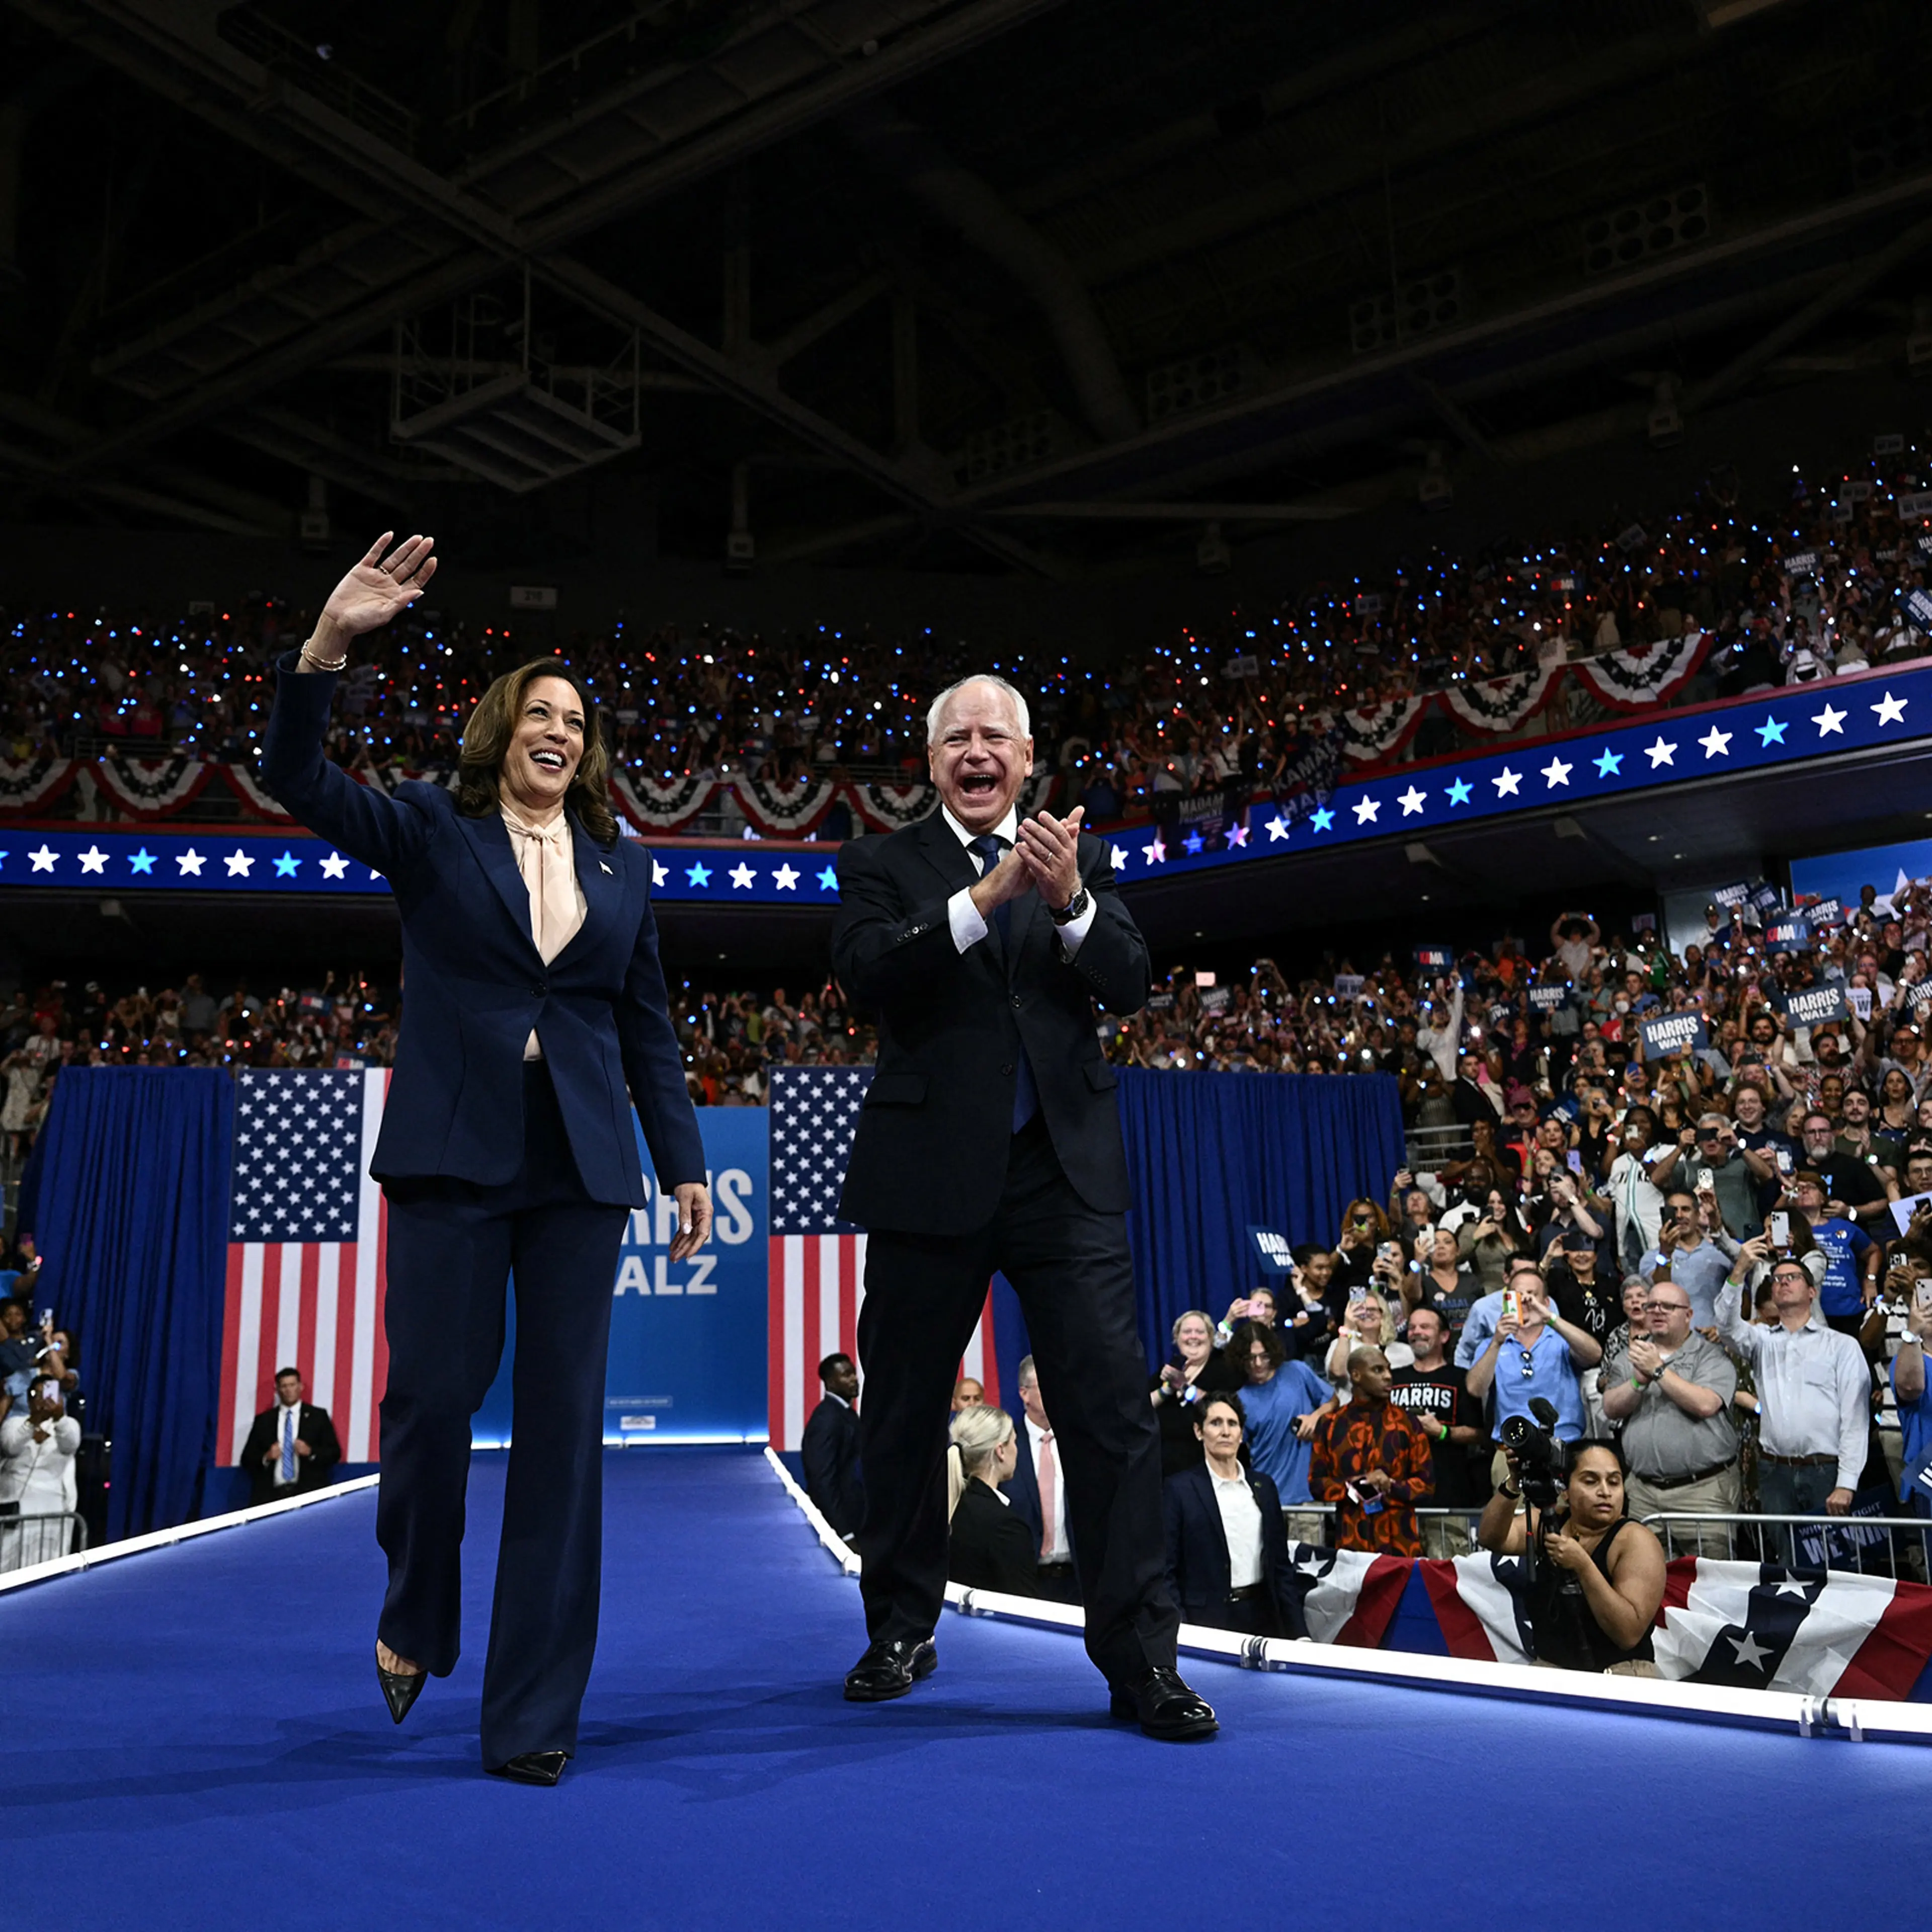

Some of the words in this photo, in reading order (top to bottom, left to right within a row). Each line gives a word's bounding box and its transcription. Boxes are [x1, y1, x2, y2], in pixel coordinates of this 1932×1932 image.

[1784, 552, 1816, 570] HARRIS
[1766, 924, 1807, 942] KAMALA
[1530, 987, 1565, 1002] HARRIS
[1788, 987, 1840, 1015] HARRIS
[1799, 1005, 1836, 1022] WALZ
[1646, 1015, 1700, 1043] HARRIS
[1272, 1253, 1296, 1267] WA
[613, 1255, 717, 1296] ALZ
[1390, 1387, 1453, 1409] HARRIS
[1801, 1530, 1843, 1565] WE
